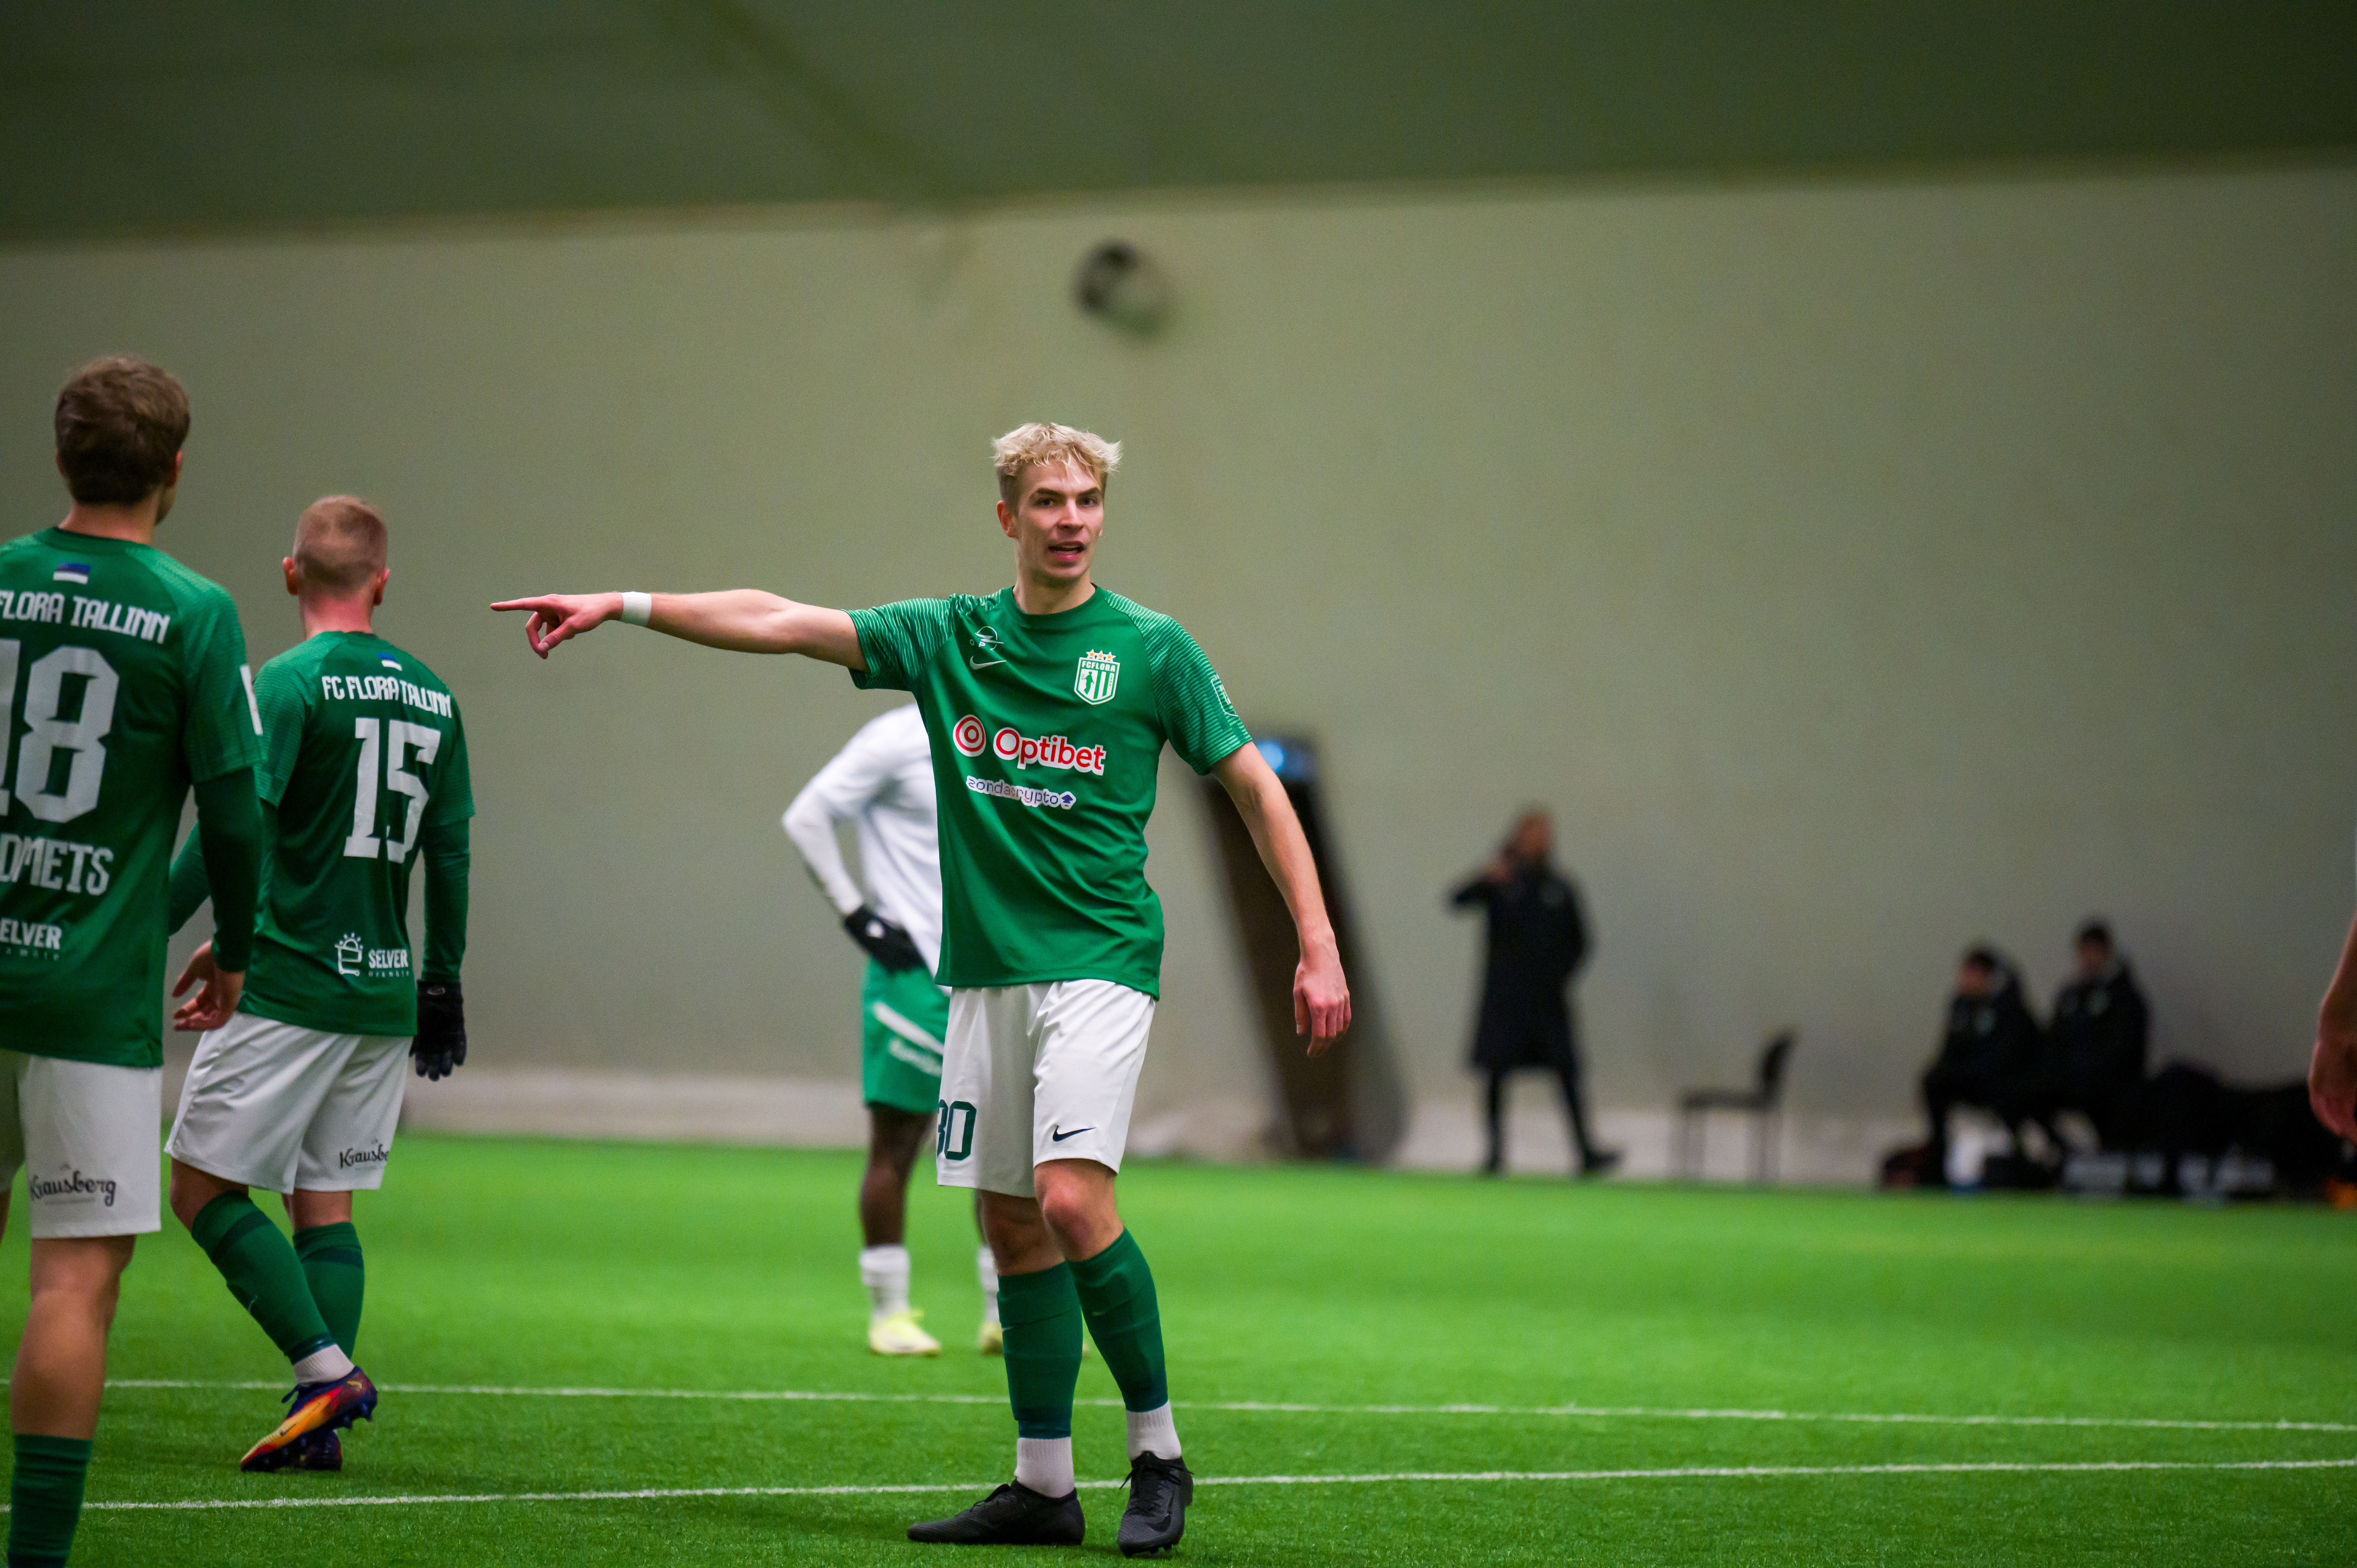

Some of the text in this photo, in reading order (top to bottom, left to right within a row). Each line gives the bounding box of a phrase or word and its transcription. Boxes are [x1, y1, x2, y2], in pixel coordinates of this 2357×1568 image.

[70, 595, 171, 644] TALLINN
[322, 675, 452, 718] FC FLORA TALLINN
[996, 729, 1104, 770] Optibet
[343, 717, 441, 863] 15
[968, 779, 1059, 805] zondacrypto
[369, 949, 408, 969] SELVER
